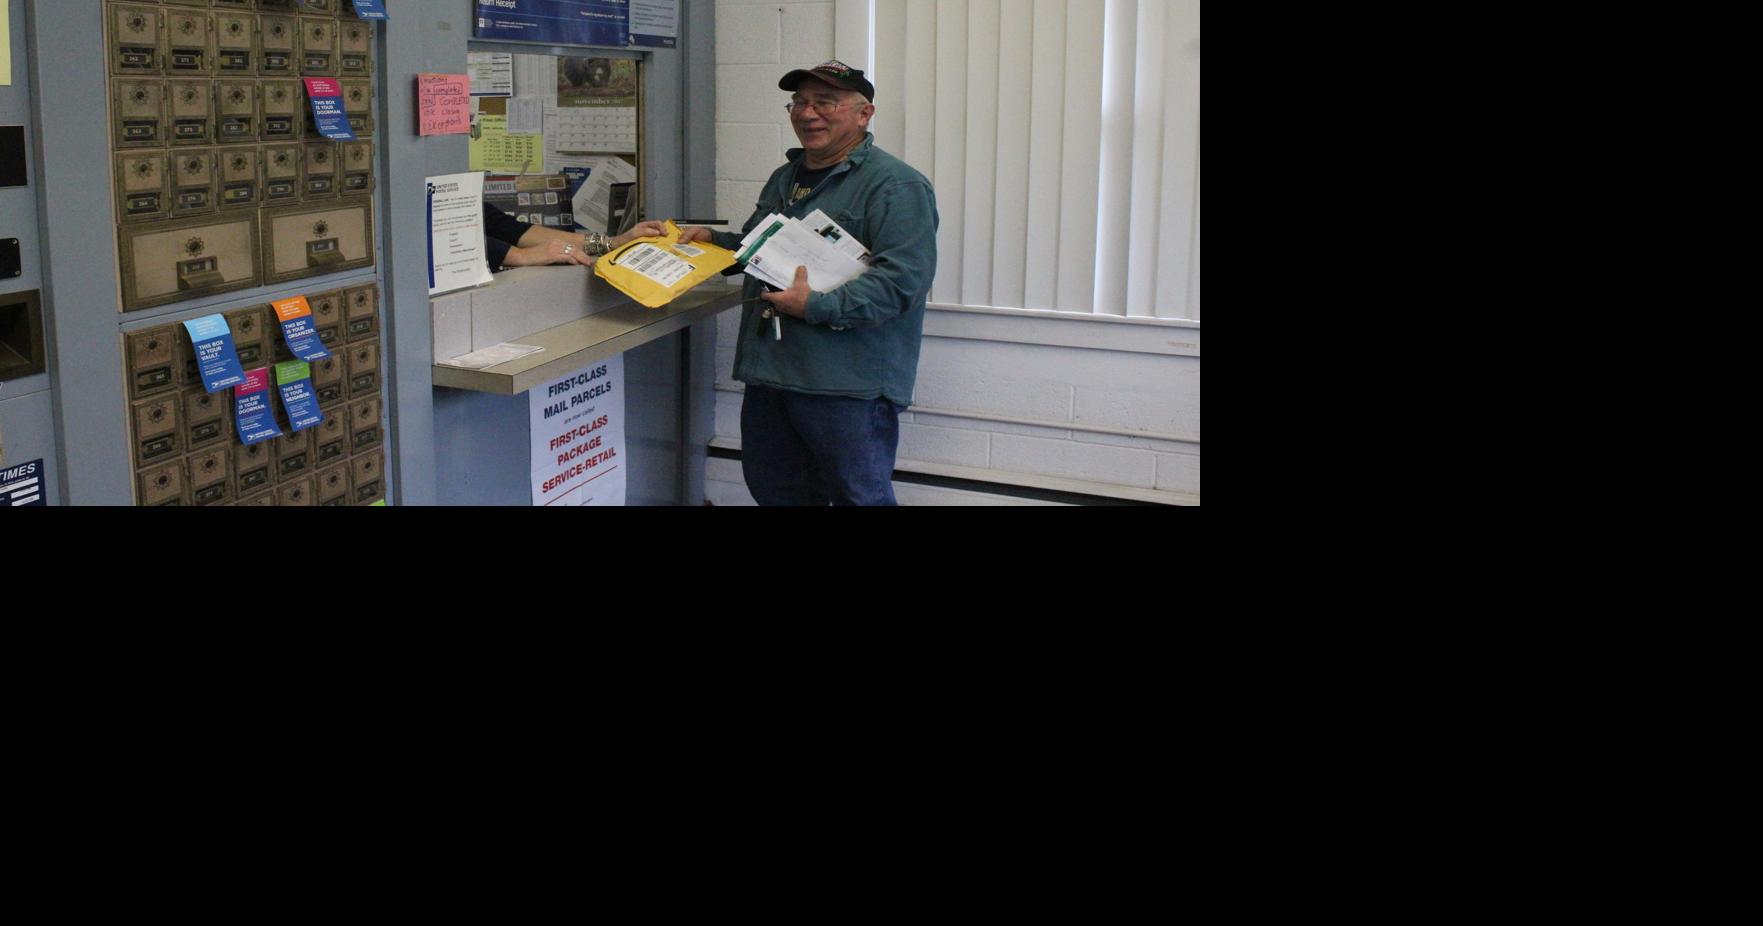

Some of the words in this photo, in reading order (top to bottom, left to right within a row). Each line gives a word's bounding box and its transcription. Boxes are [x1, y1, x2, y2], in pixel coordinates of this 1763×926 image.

[484, 183, 512, 191] LIMITED
[206, 346, 222, 354] YOUR
[548, 365, 608, 398] FIRST-CLASS
[544, 403, 568, 419] MAIL
[571, 381, 612, 408] PARCELS
[582, 406, 595, 416] called
[549, 415, 608, 451] FIRST-CLASS
[557, 436, 602, 466] PACKAGE
[542, 447, 617, 494] SERVICE-RETAIL
